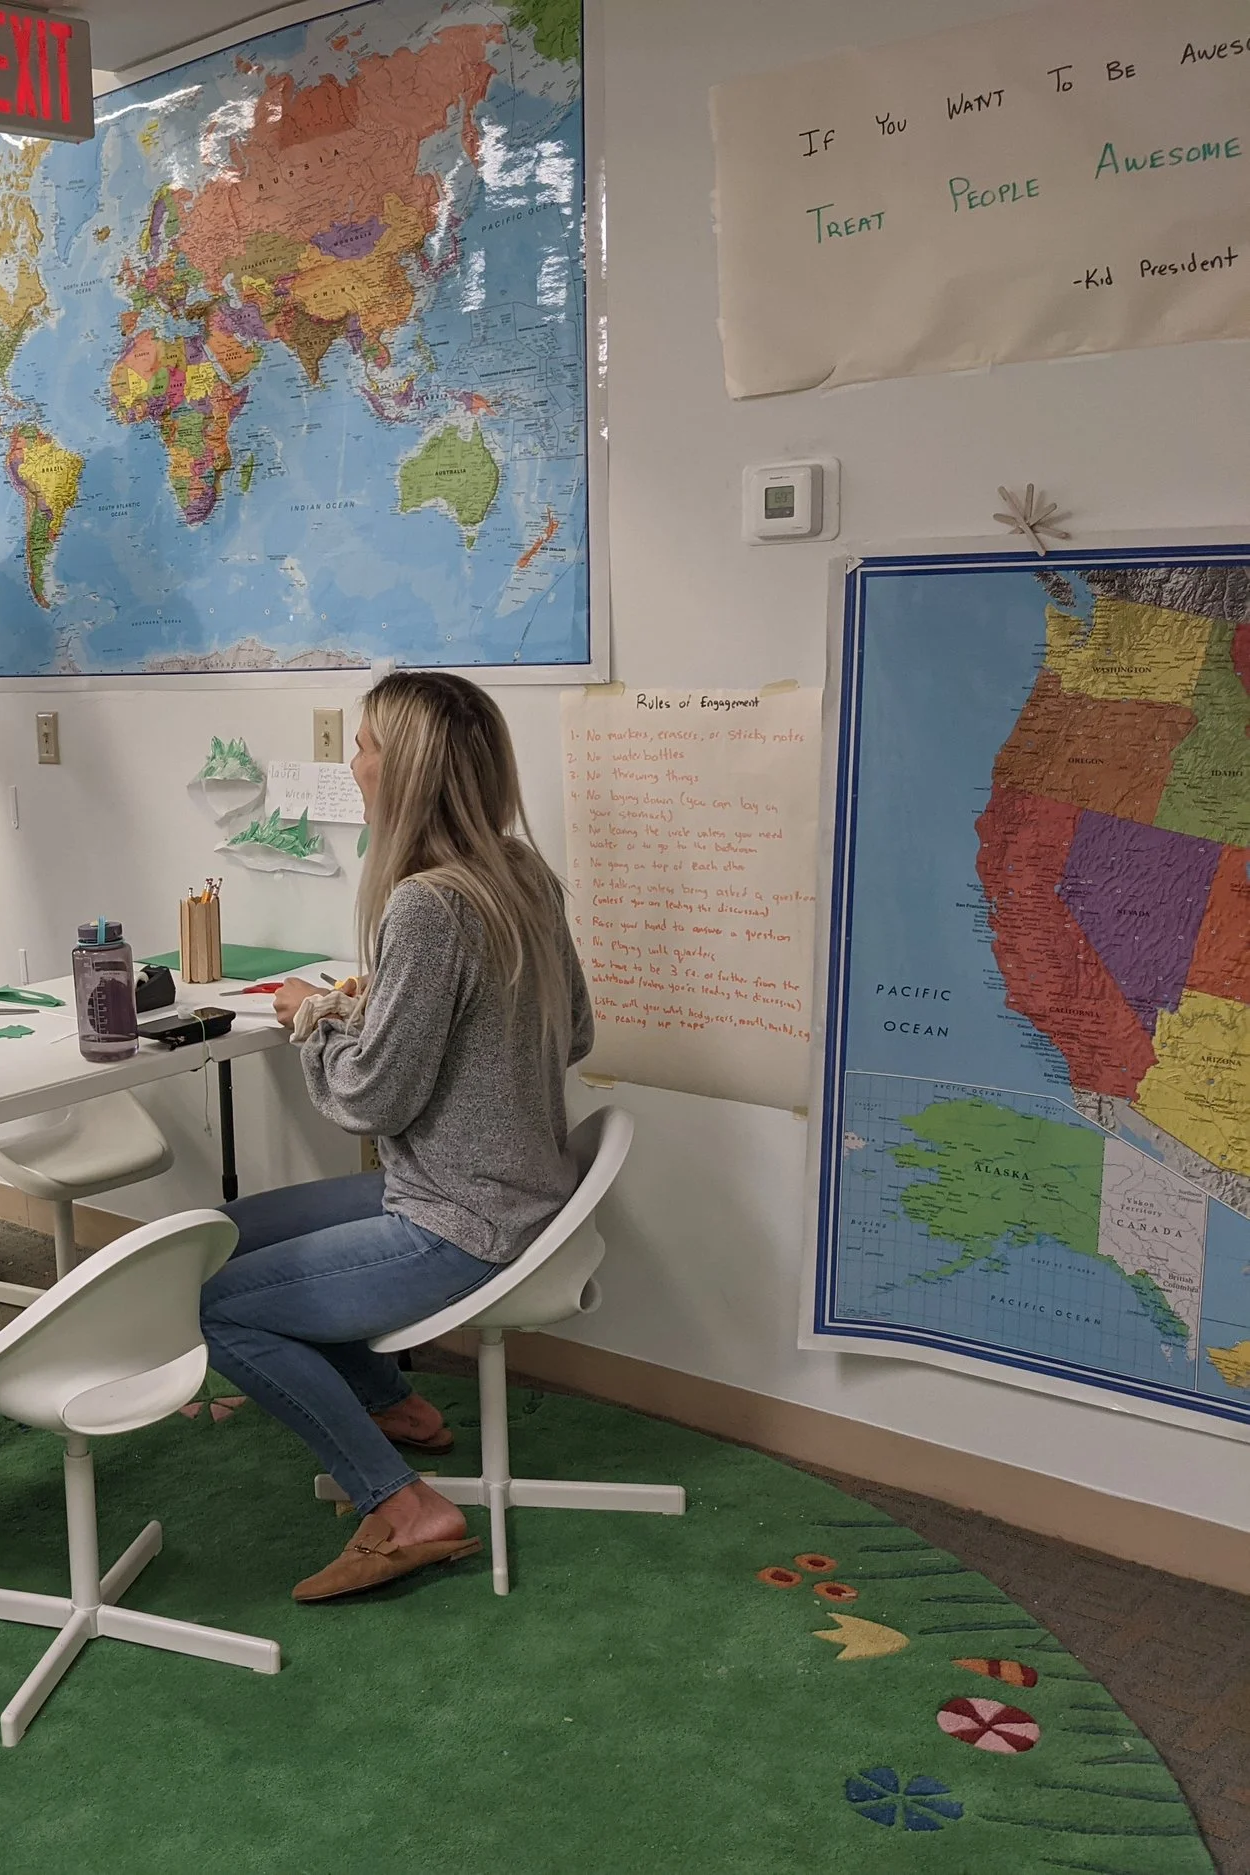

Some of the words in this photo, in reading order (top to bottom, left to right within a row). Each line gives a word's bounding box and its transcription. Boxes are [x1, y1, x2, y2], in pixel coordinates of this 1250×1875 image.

[947, 89, 1005, 120] WANT
[1106, 61, 1136, 81] BE
[806, 203, 885, 244] TREAT
[949, 177, 1040, 212] PEOPLE
[1094, 137, 1242, 179] AWESOME
[481, 212, 524, 233] PACIFIC
[1141, 249, 1238, 277] President
[41, 465, 64, 474] BRAZIL
[434, 468, 467, 476] AUSTRALIA
[290, 503, 321, 512] INDIAN
[326, 500, 355, 510] OCEAN
[636, 693, 671, 709] Rules
[700, 696, 760, 711] Engagement
[587, 729, 601, 741] No
[587, 751, 601, 762] No
[587, 770, 601, 781] No
[666, 768, 699, 785] things
[587, 789, 601, 800] No
[1117, 909, 1151, 917] NEVADA
[876, 983, 952, 1002] PACIFIC
[1049, 1006, 1101, 1018] CALIFORNIA
[883, 1020, 950, 1038] OCEAN
[1200, 1055, 1242, 1067] ARIZONA
[974, 1164, 1029, 1180] ALASKA
[1127, 1197, 1154, 1208] Yukon
[1120, 1204, 1162, 1217] Territory
[1117, 1219, 1183, 1238] CANADA
[1168, 1273, 1193, 1284] British
[991, 1295, 1045, 1313] PACIFIC
[1055, 1309, 1101, 1325] OCEAN
